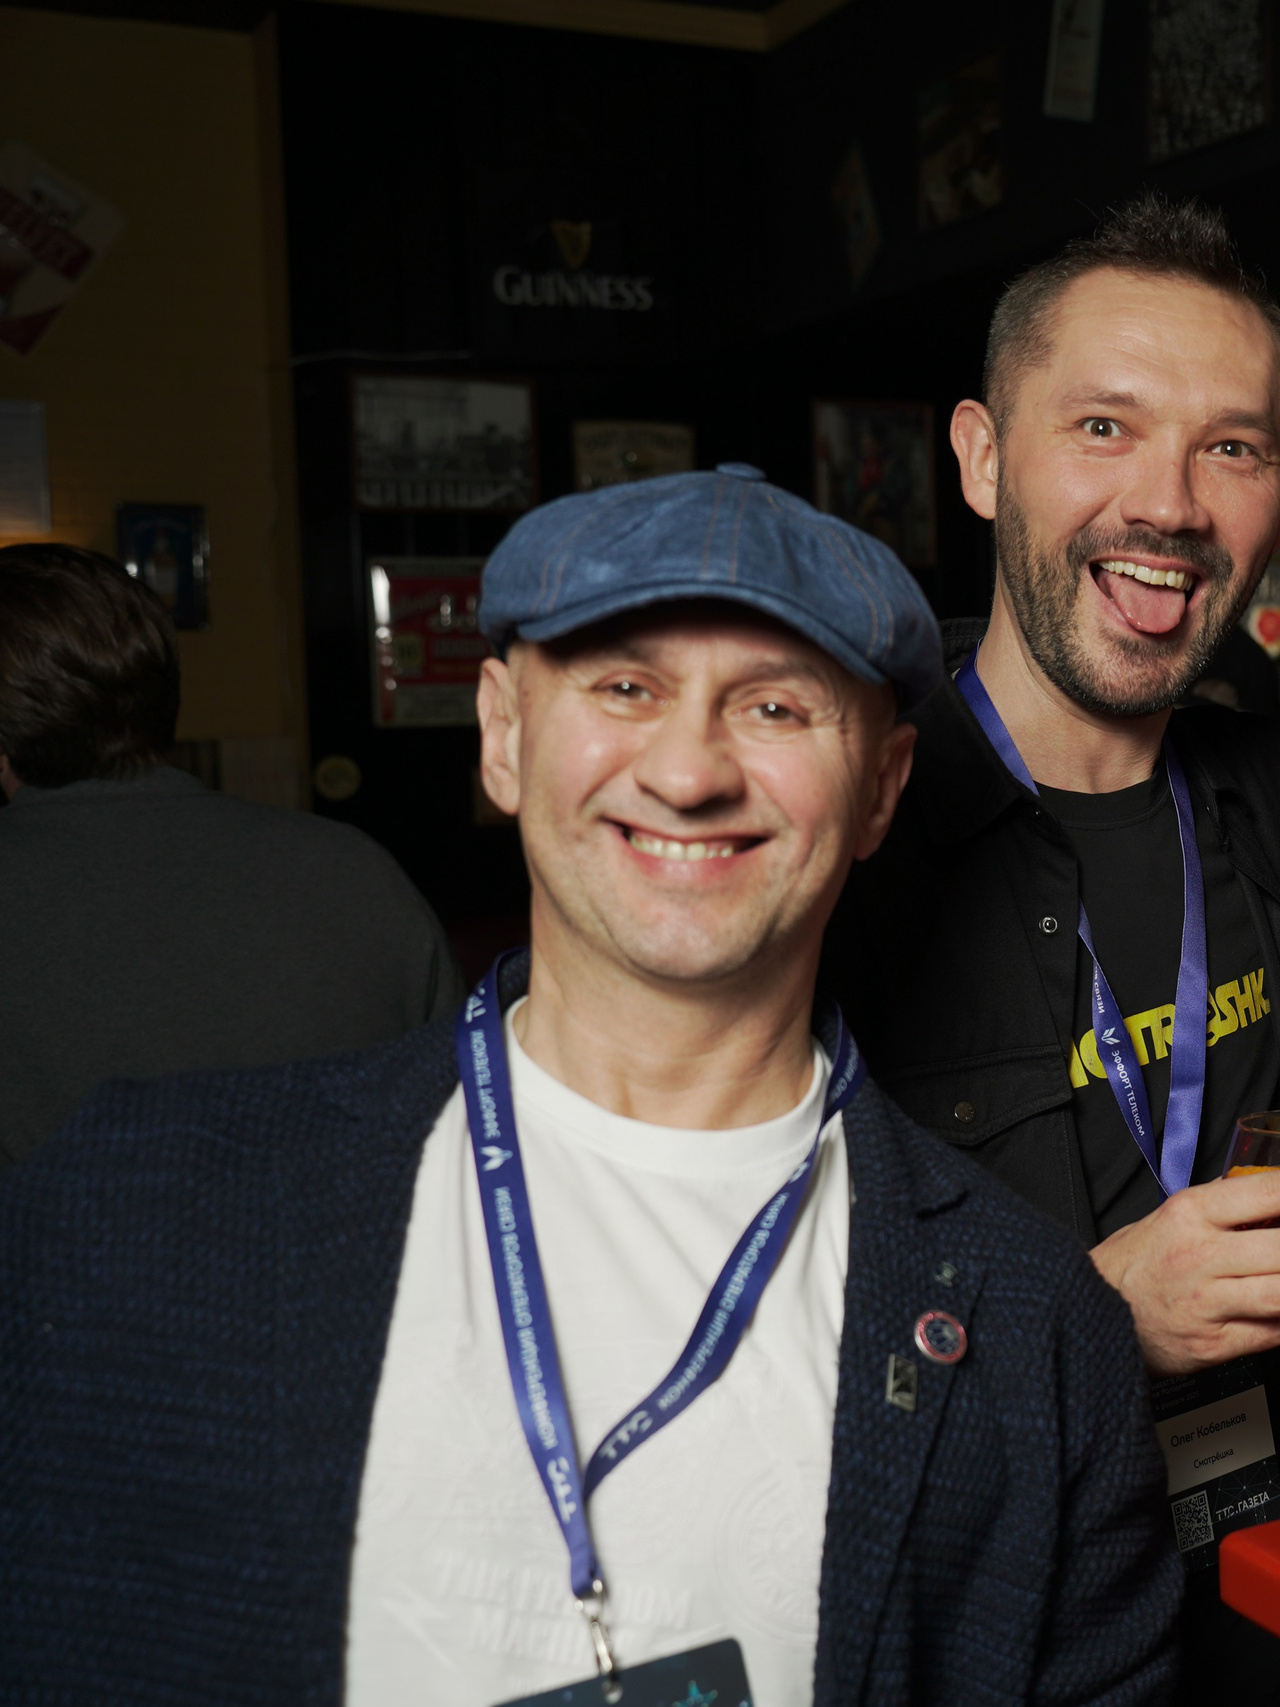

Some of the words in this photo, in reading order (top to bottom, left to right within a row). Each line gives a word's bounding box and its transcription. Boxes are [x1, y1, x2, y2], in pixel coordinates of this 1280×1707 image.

[493, 263, 654, 312] GUINNESS
[1094, 982, 1106, 1014] СВЯЗИ
[1111, 1050, 1132, 1089] ЭФФОРТ
[1126, 1088, 1145, 1137] ТЕЛЕКОМ
[600, 1410, 653, 1460] ТТС
[1170, 1432, 1195, 1447] Олег
[1196, 1413, 1247, 1439] Кобельков
[1193, 1447, 1234, 1469] Смотрёшка
[547, 1456, 577, 1524] ТТС
[1215, 1491, 1270, 1521] ТТС.ГАЗЕТА
